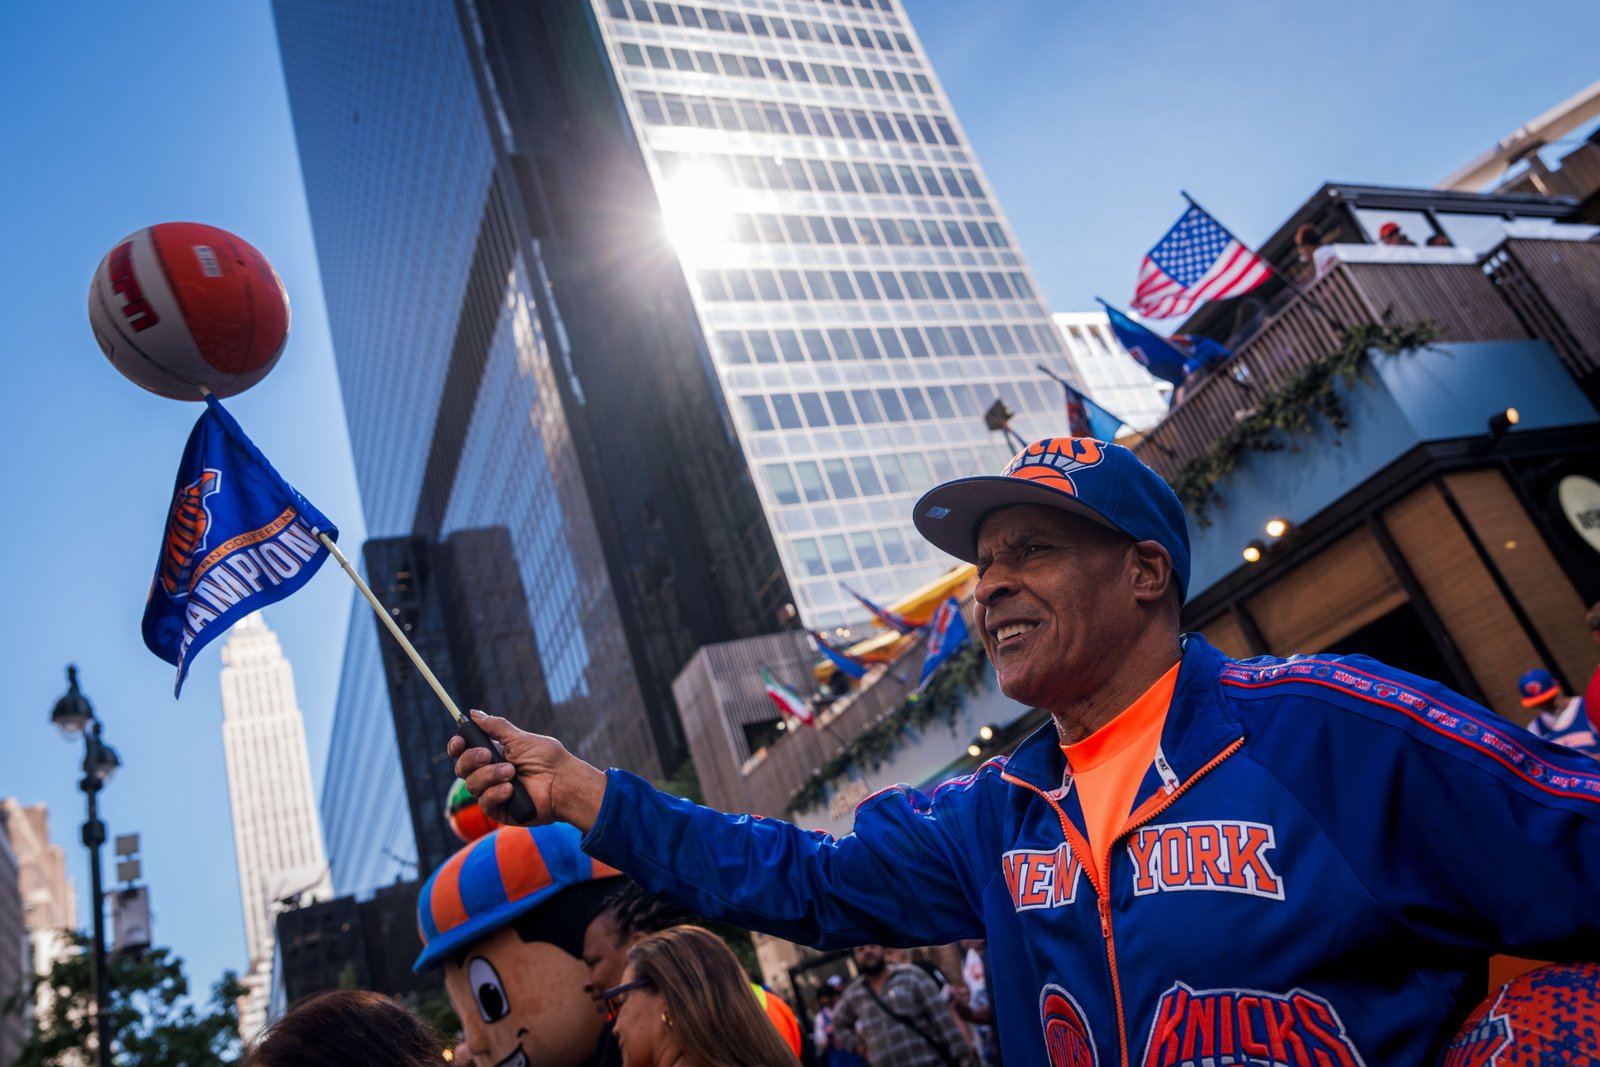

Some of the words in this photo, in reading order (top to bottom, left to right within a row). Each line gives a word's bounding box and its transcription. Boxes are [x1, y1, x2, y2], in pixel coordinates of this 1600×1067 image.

[1332, 669, 1373, 692] KNICKS
[1397, 691, 1427, 711] NEW
[1427, 707, 1460, 728] YORK
[1481, 731, 1525, 763] KNICKS
[1158, 757, 1169, 772] NIKE
[1003, 844, 1079, 909] NEW
[1128, 822, 1283, 897] YORK
[1146, 986, 1363, 1067] KNICKS
